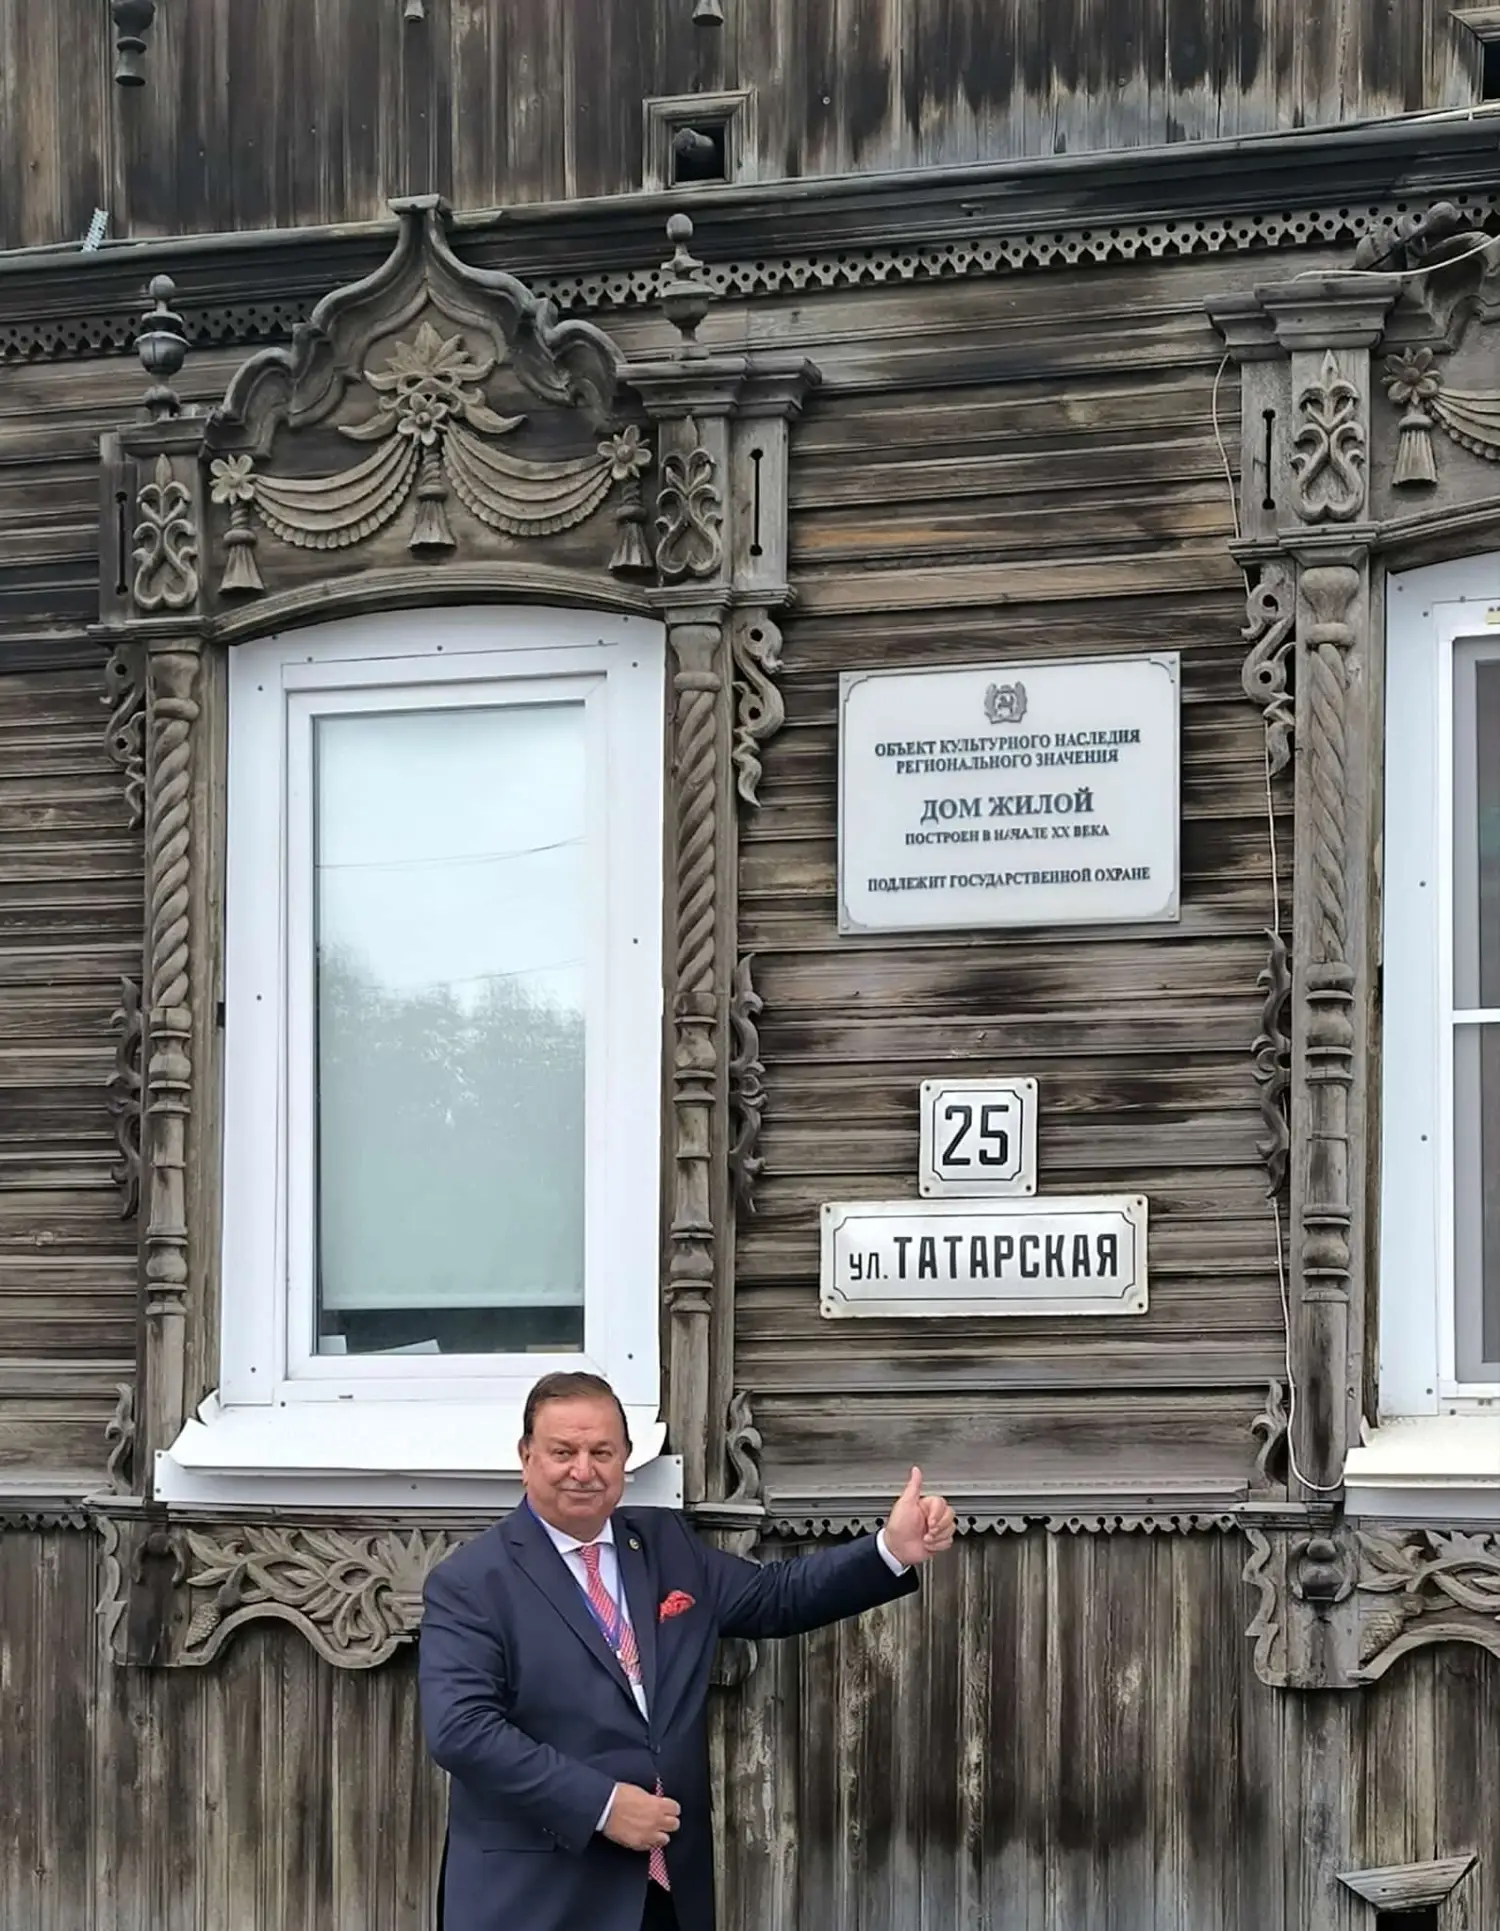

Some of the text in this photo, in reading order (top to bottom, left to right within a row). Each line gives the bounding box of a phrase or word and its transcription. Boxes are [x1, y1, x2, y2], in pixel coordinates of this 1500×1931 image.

[874, 728, 1141, 758] ОБЪЕКТ КУЛЬТУРНОГО НАСЛЕДИЯ
[896, 748, 1119, 775] РЕГИОНАЛЬНОГО ЗНАЧЕНИЯ
[919, 786, 1095, 826] ДОМ ЖИЛОЙ
[905, 829, 980, 846] ПОСТРОЕН
[982, 829, 992, 843] В
[1073, 824, 1110, 839] ВЕКА
[867, 866, 1151, 893] ПОДЛЕЖИТ ГОСУДАРСТВЕННОЙ ОХРАНЕ
[942, 1104, 1010, 1166] 25
[849, 1233, 1118, 1281] ул. ТАТАРСКАЯ
